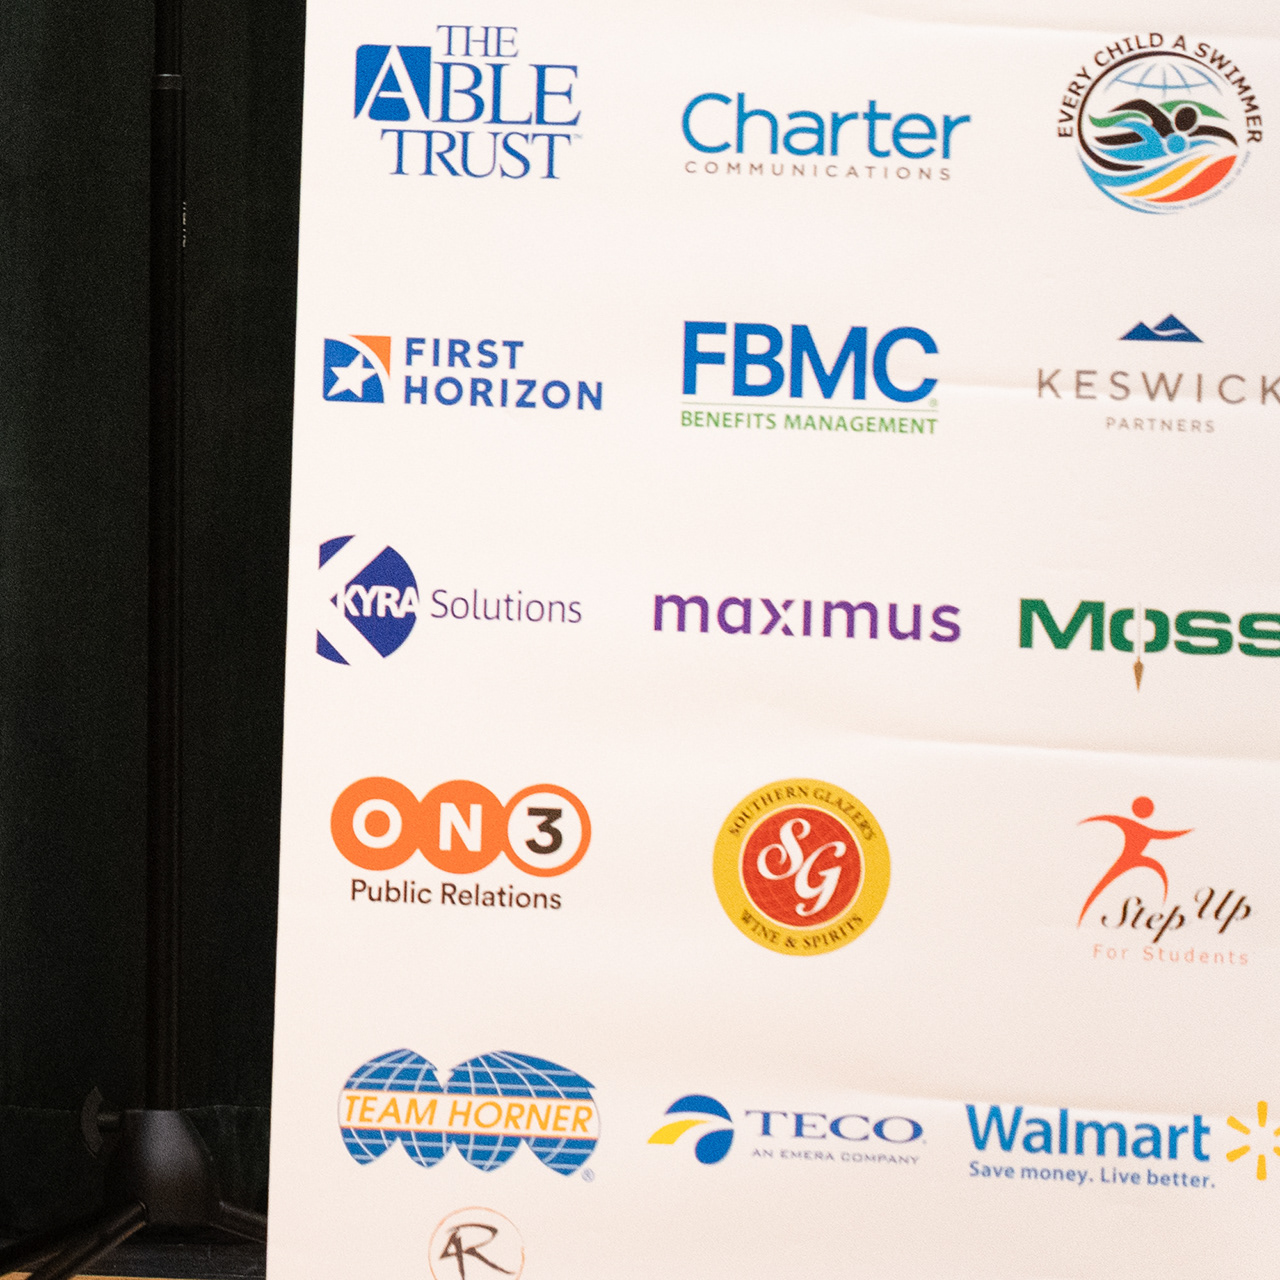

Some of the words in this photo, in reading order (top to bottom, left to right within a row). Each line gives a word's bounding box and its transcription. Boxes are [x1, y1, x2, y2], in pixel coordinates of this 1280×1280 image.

[436, 24, 519, 58] THE
[354, 44, 582, 125] ABLE
[1057, 65, 1094, 138] EVERY
[1094, 32, 1164, 67] CHILD
[1172, 35, 1187, 51] A
[1194, 42, 1263, 144] SWIMMER
[681, 91, 972, 159] Charter
[380, 129, 572, 180] TRUST
[683, 160, 952, 182] COMMUNICATIONS
[404, 337, 524, 370] FIRST
[681, 320, 939, 404] FBMC
[404, 375, 604, 411] HORIZON
[1037, 367, 1280, 405] KESWICK
[681, 409, 777, 430] BENEFITS
[784, 413, 938, 435] MANAGEMENT
[1106, 416, 1216, 433] PARTNERS
[339, 584, 419, 618] KYRA
[431, 589, 582, 625] Solutions
[653, 592, 963, 643] maximus
[728, 786, 811, 837] SOUTHERN
[351, 878, 432, 905] Public
[441, 884, 562, 910] Relations
[739, 908, 780, 945] WINE
[784, 935, 798, 950] &
[802, 914, 865, 950] SPIRITS
[1101, 896, 1186, 944] Step
[1195, 887, 1252, 934] Up
[1093, 944, 1129, 959] For
[1143, 947, 1249, 965] Students
[345, 1094, 436, 1126] TEAM
[450, 1100, 594, 1134] HORNER
[744, 1110, 923, 1144] TECO
[966, 1103, 1211, 1162] Walmart
[751, 1148, 774, 1159] AN
[780, 1150, 835, 1162] EMERA
[841, 1152, 921, 1166] COMPANY
[969, 1161, 1015, 1179] Save
[1021, 1165, 1094, 1186] money.
[1101, 1167, 1141, 1184] Live
[1147, 1170, 1215, 1189] better.
